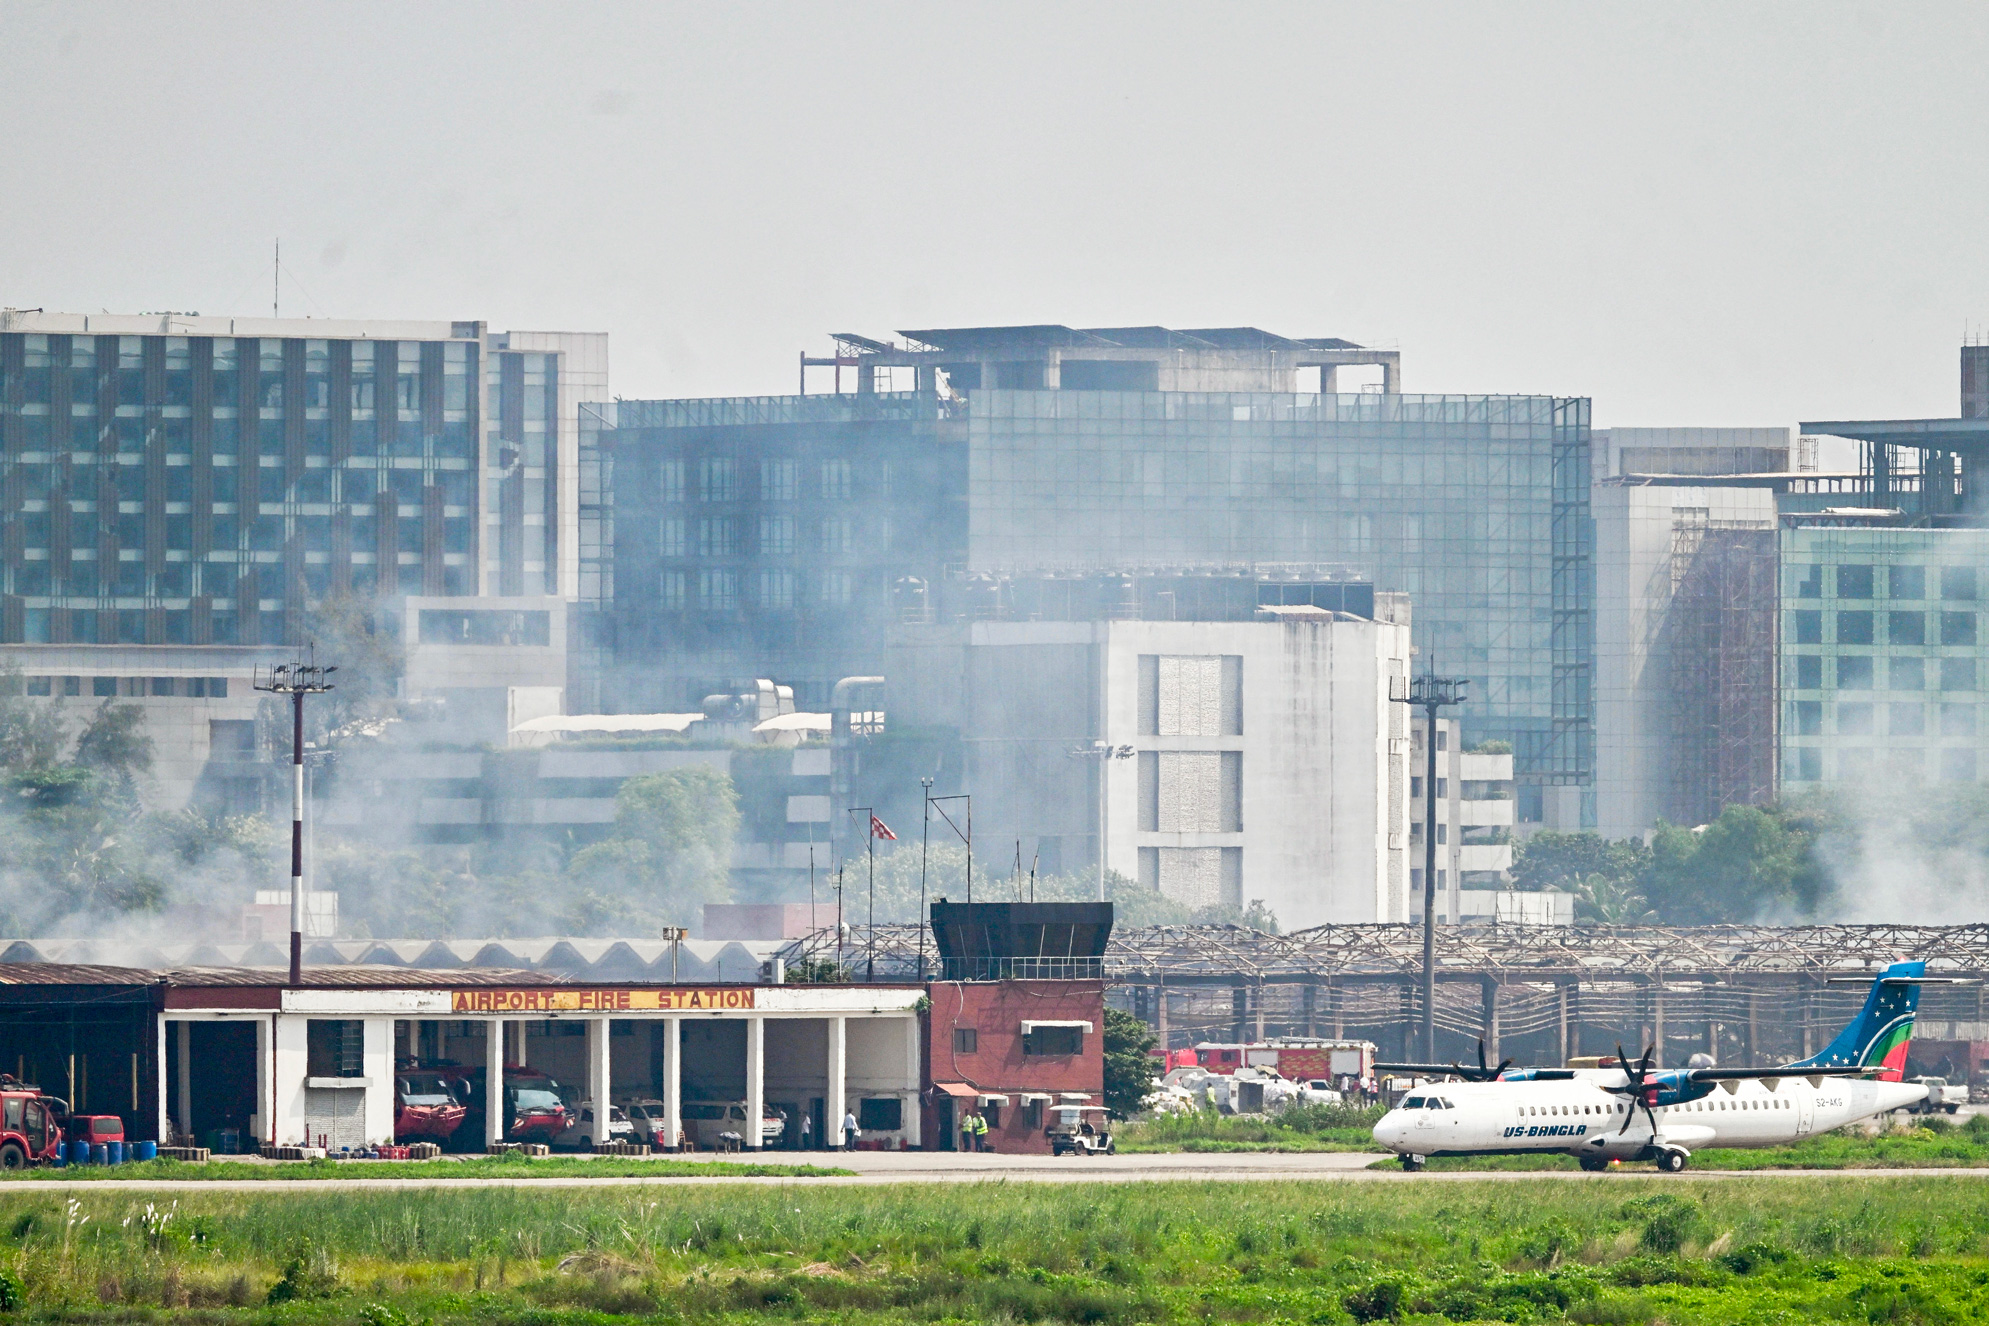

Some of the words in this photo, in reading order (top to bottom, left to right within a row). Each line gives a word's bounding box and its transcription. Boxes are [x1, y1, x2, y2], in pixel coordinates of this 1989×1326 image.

[456, 992, 554, 1010] AIRPORT
[580, 991, 630, 1009] FIRE
[658, 991, 755, 1009] STATION
[1816, 1098, 1843, 1108] S2-AKG
[1503, 1125, 1587, 1138] US-BANGLA
